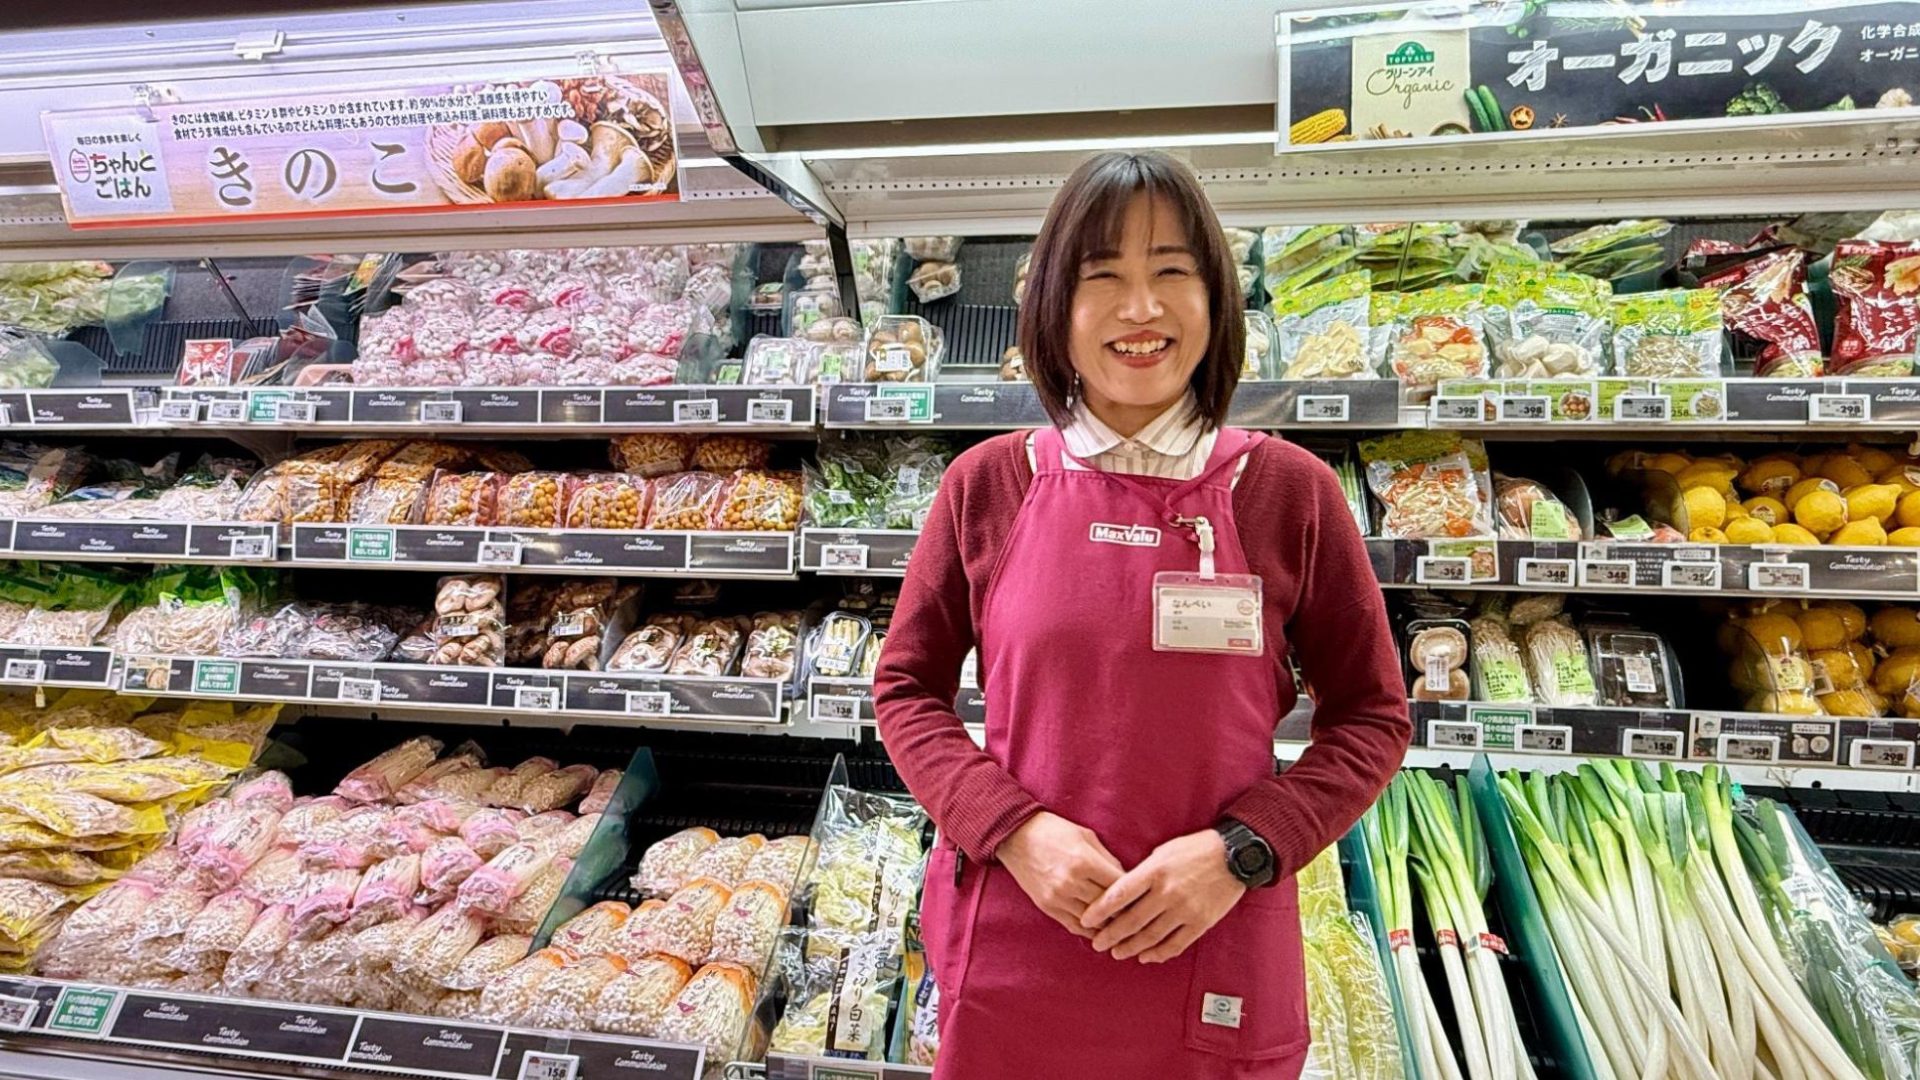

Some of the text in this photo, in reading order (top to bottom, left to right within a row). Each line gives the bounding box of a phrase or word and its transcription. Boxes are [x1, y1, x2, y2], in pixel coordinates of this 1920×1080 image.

[1389, 54, 1433, 64] TOPVALU
[1507, 20, 1842, 91] オーガニック
[1860, 46, 1919, 62] オーガニ
[1385, 66, 1434, 79] グリーンアイ
[1366, 68, 1454, 109] Organic
[90, 150, 157, 174] ちゃんと
[209, 141, 417, 206] きのこ
[95, 176, 151, 199] ごはん
[1766, 394, 1811, 402] Communicat
[1875, 394, 1920, 402] Communicat
[1095, 524, 1155, 543] MaxValu
[1844, 555, 1871, 564] Tasty
[295, 1015, 318, 1026] Tasty
[218, 1026, 240, 1037] Tasty
[439, 1029, 462, 1040] Tasty
[359, 1041, 382, 1052] Tasty
[631, 1050, 655, 1061] Tasty
[547, 1066, 566, 1078] 158
